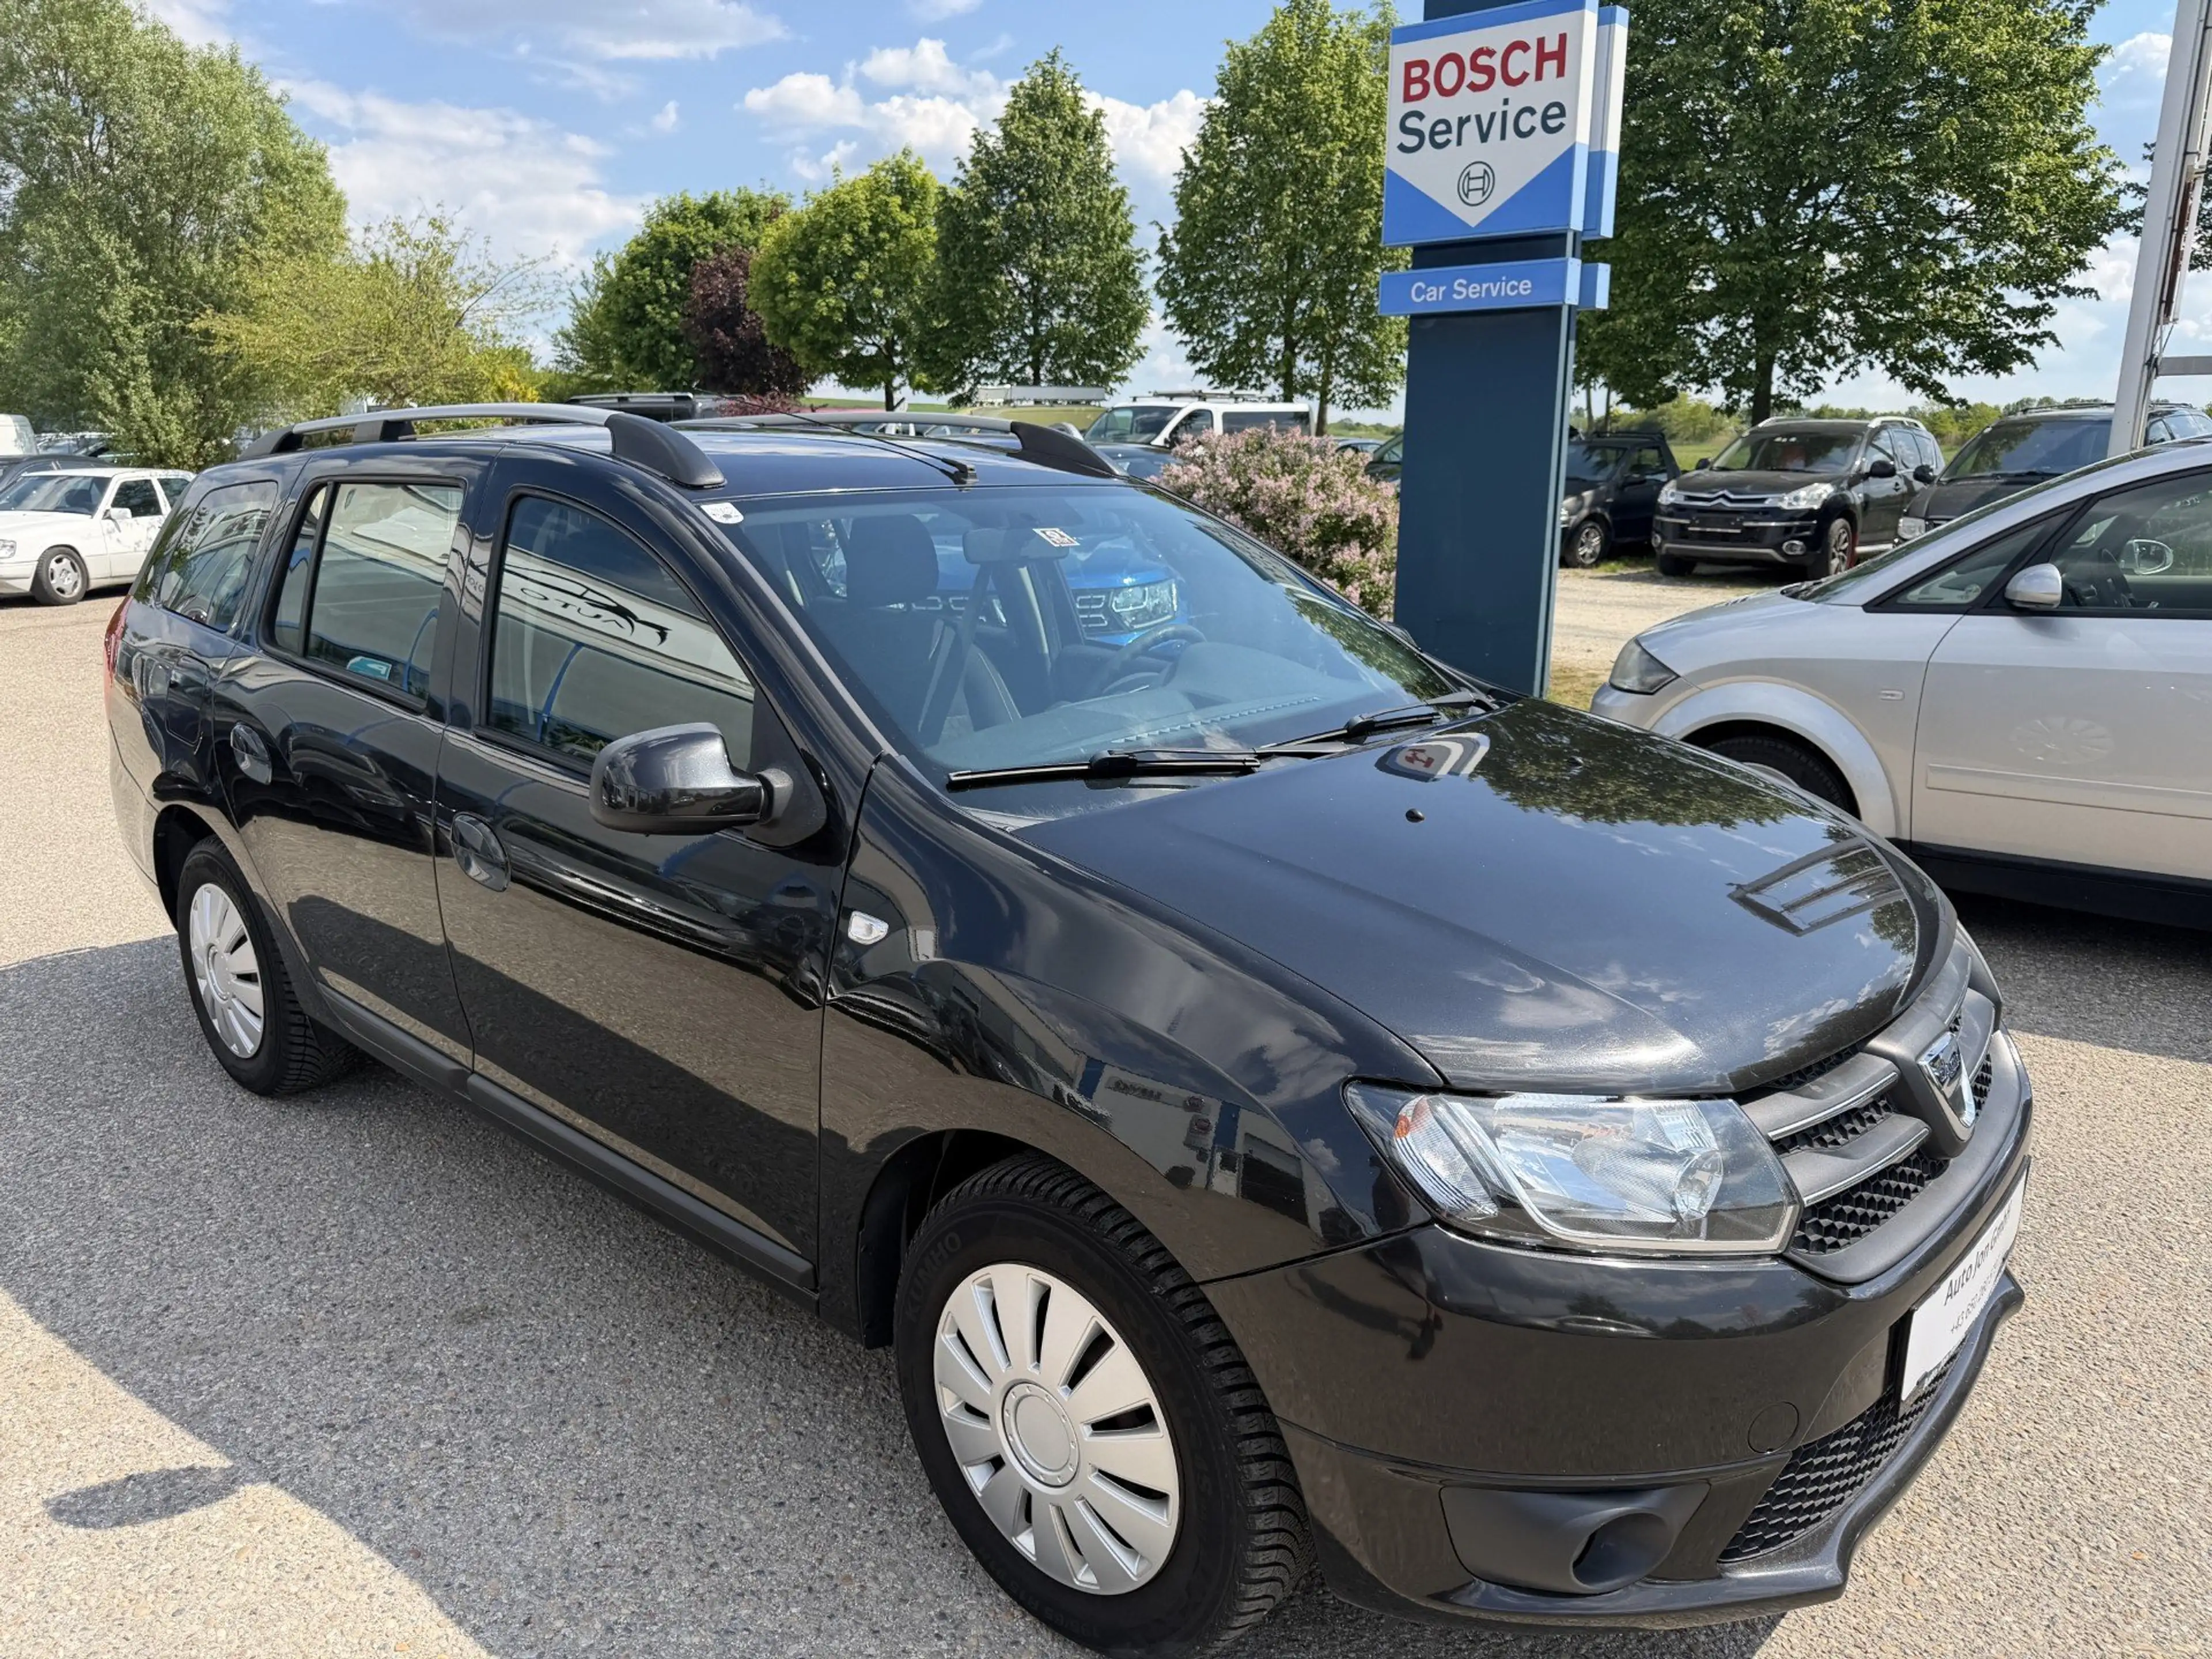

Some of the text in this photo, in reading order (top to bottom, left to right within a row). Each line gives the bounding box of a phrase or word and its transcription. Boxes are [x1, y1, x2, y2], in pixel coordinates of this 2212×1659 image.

[1403, 32, 1567, 103] BOSCH
[1396, 98, 1566, 154] Service
[1411, 276, 1532, 303] Car Service
[905, 1231, 963, 1323] KUMHO
[1944, 1263, 1972, 1306] Auto
